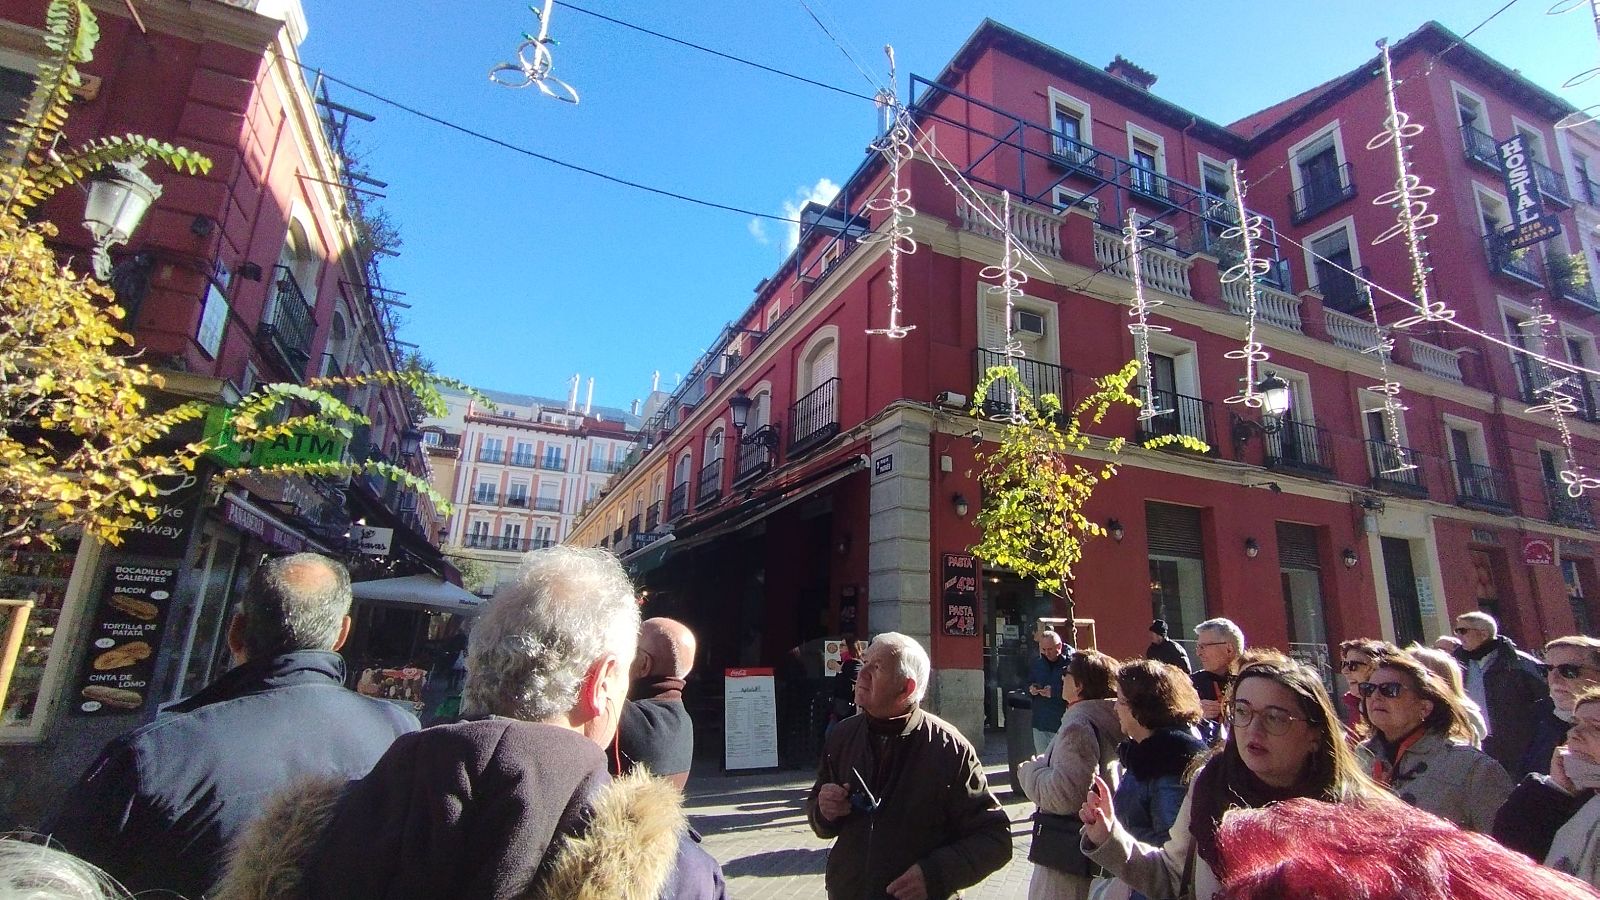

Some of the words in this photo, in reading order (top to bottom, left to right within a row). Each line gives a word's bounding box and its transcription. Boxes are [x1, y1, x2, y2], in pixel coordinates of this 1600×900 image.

[1501, 137, 1539, 225] HOSTAL
[271, 431, 336, 455] ATM
[134, 521, 183, 539] Away
[948, 556, 973, 568] PASTA
[115, 566, 173, 577] BOCADILLOS
[116, 574, 167, 583] CALIENTES
[114, 586, 146, 594] BACON
[948, 604, 974, 617] PASTA
[103, 623, 143, 631] TORTILLA
[112, 629, 144, 637] PATATA
[89, 674, 117, 682] CINTA
